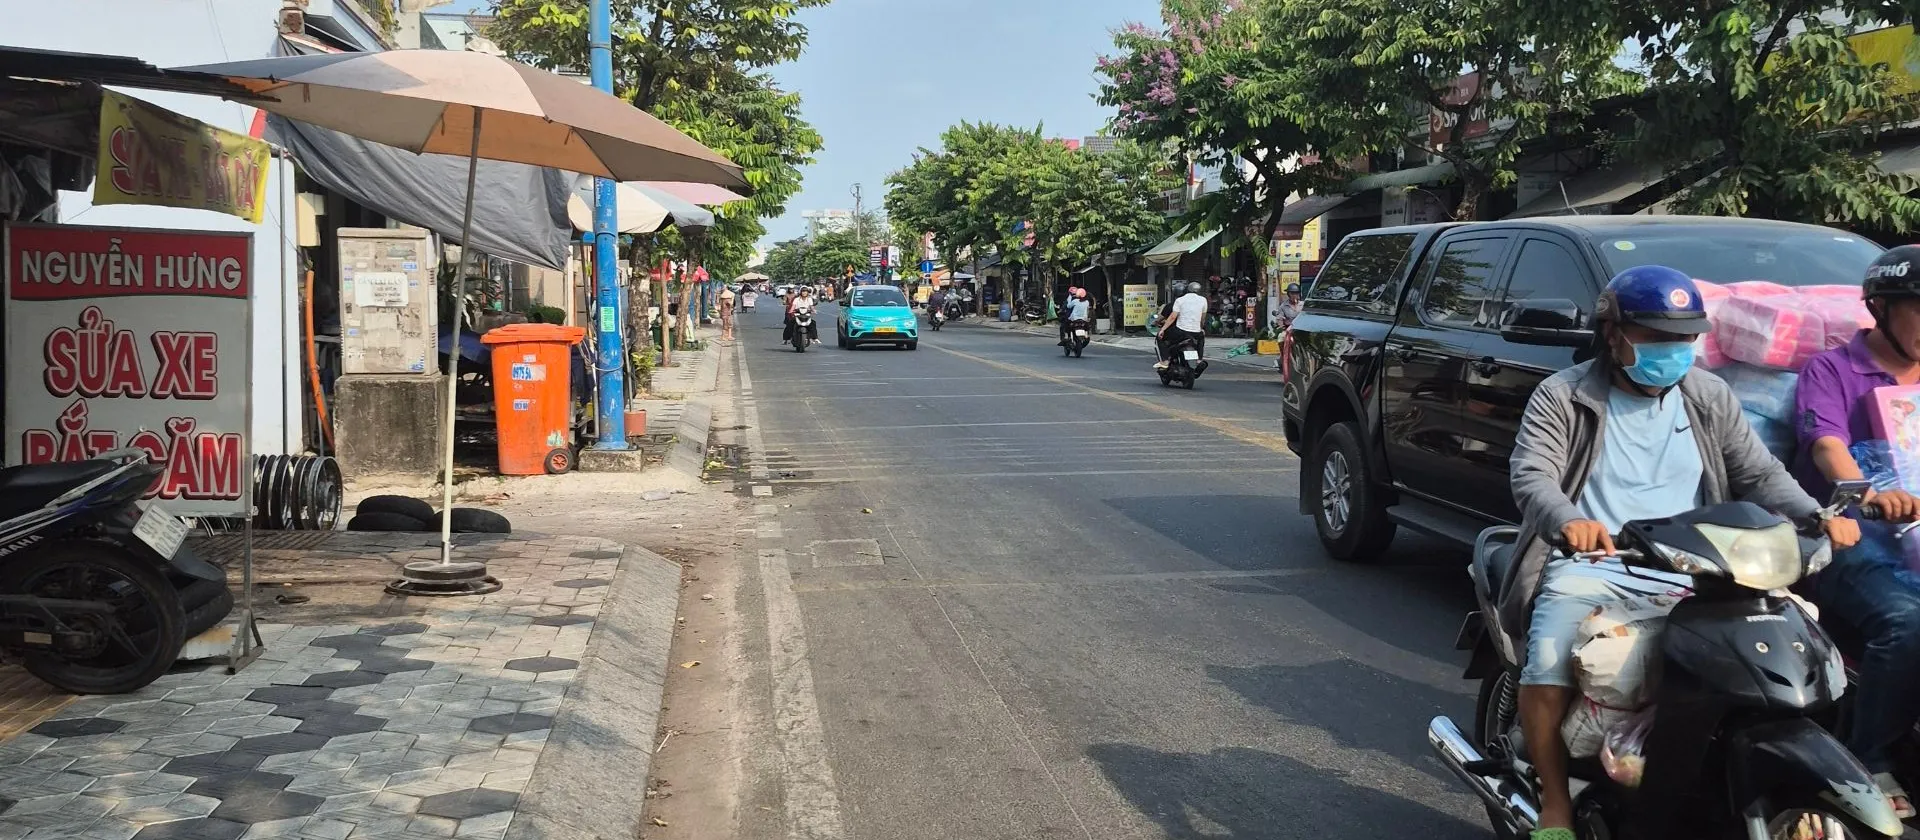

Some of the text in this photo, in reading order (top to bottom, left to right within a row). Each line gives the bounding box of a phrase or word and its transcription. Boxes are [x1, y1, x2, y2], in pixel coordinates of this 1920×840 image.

[22, 238, 242, 290] NGUYỄN HƯNG
[43, 306, 217, 400] SỬA XE
